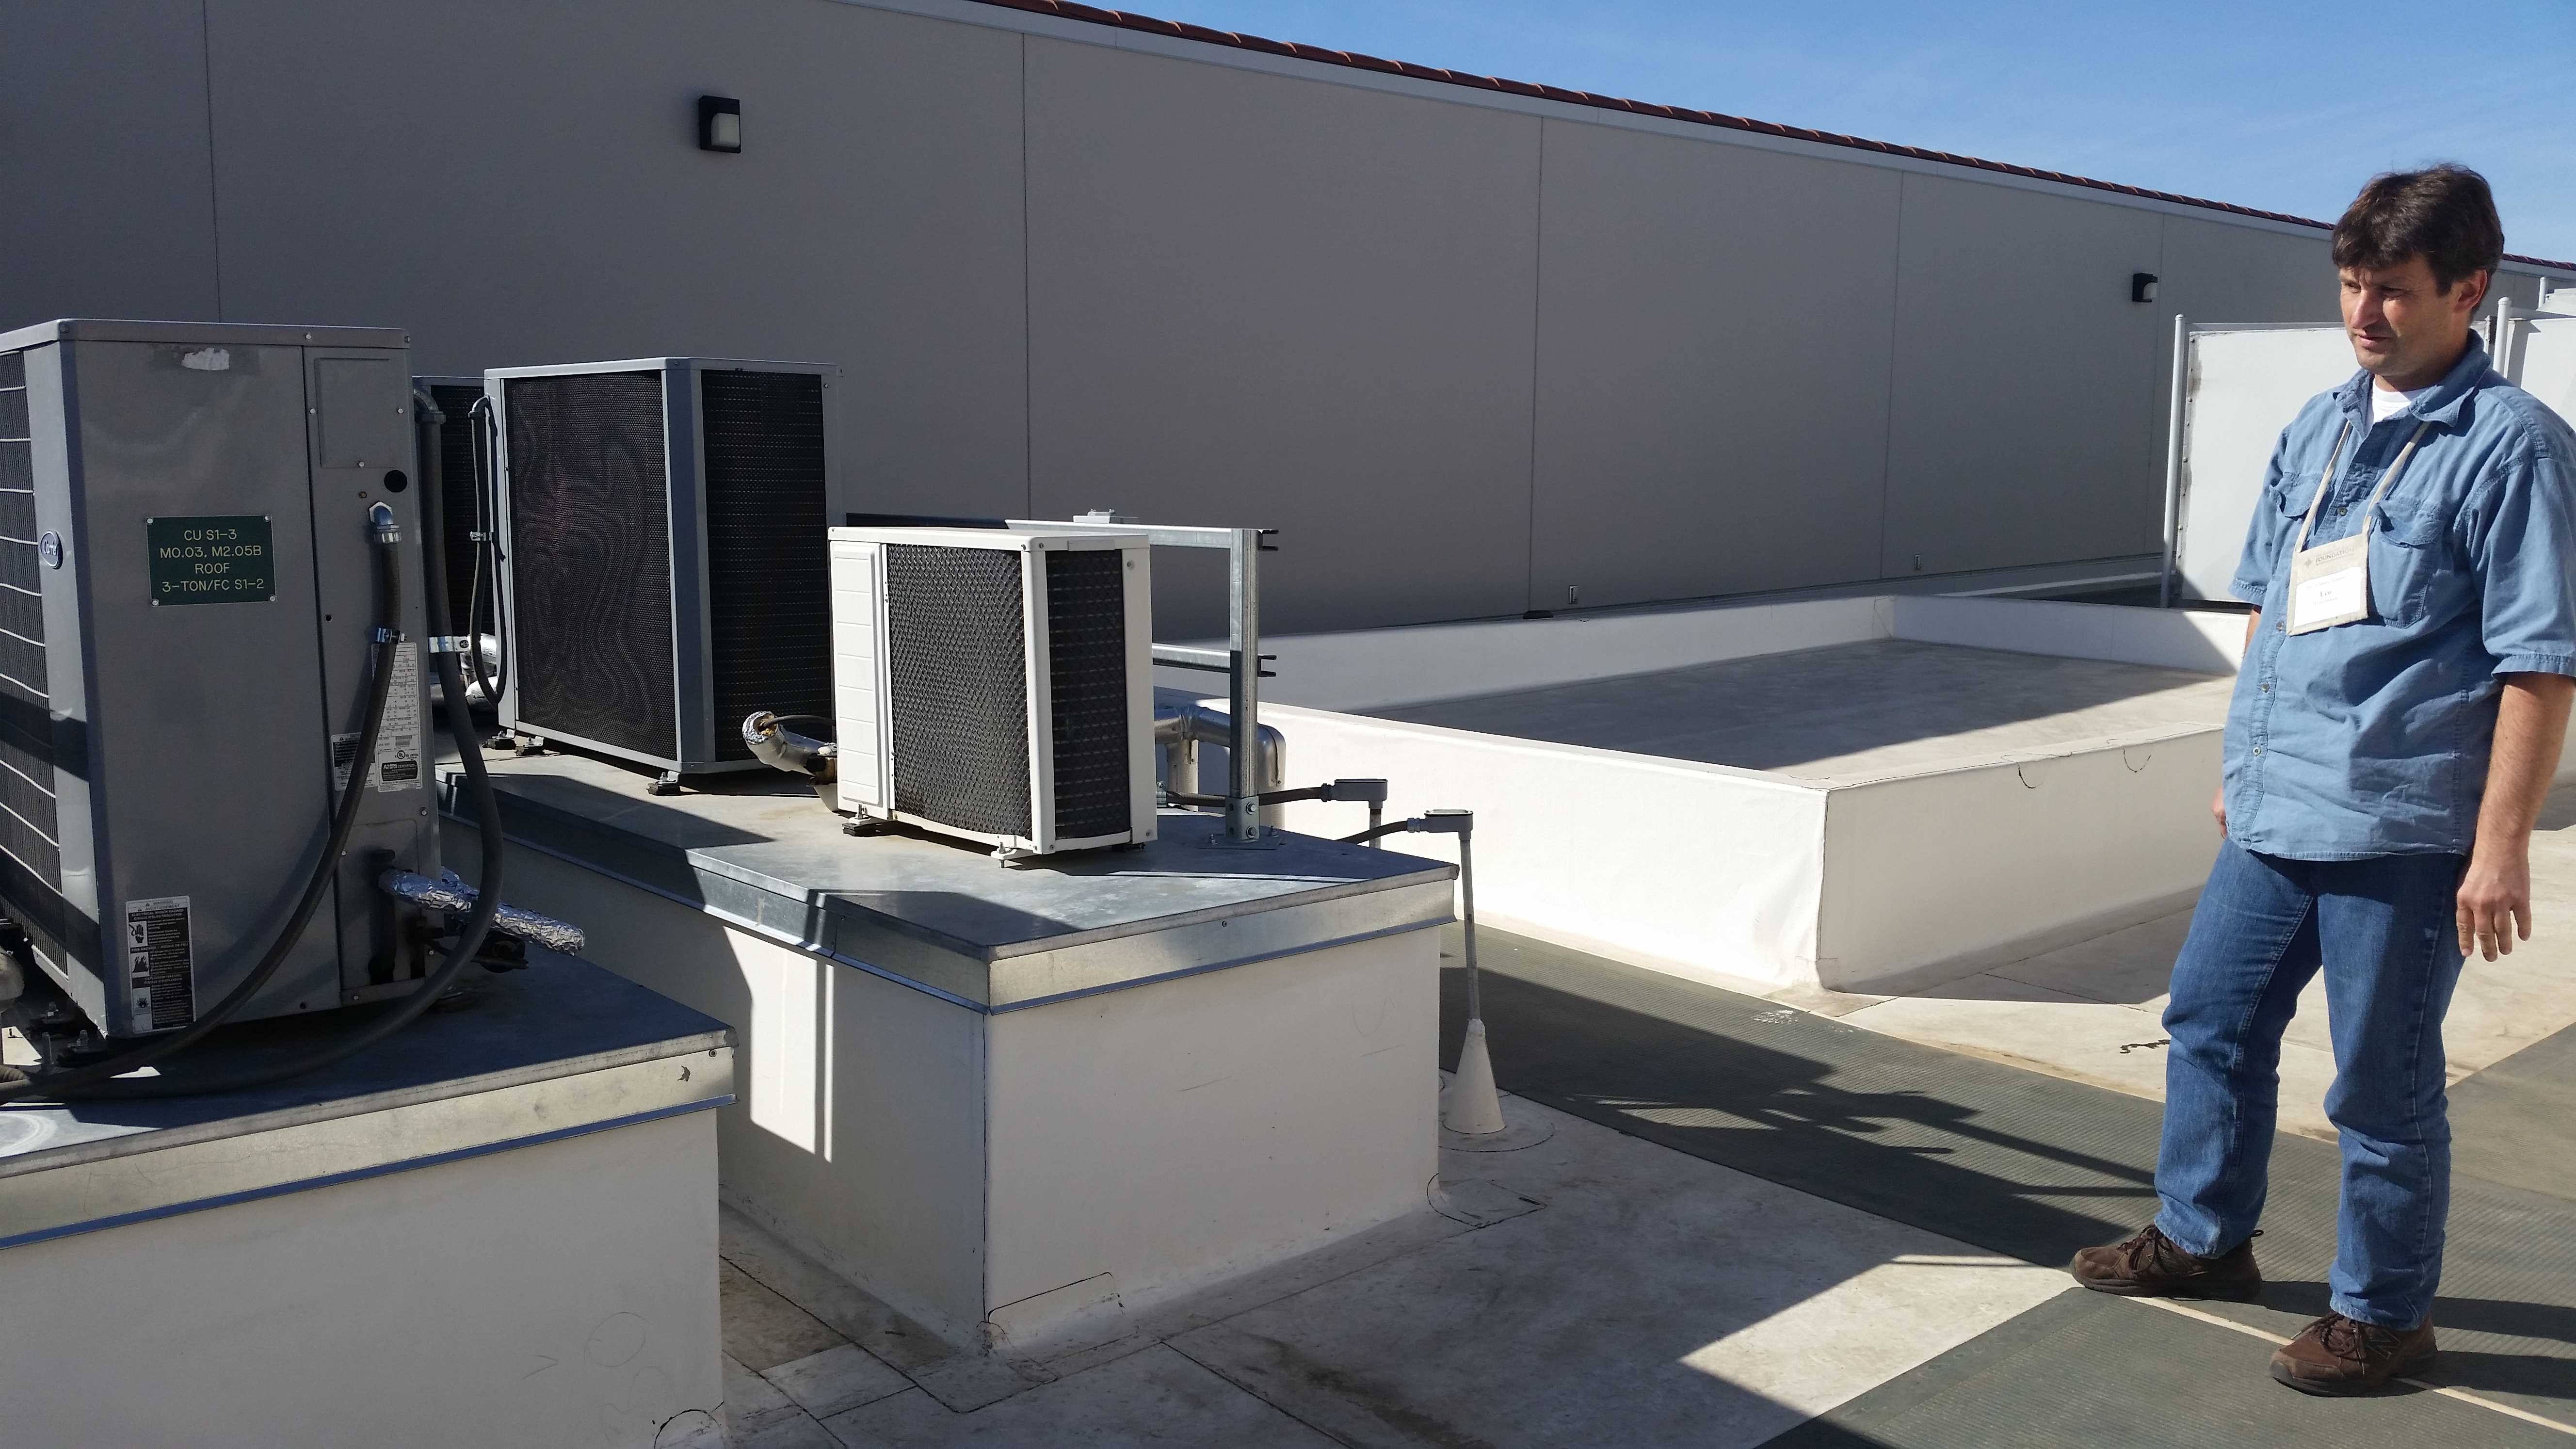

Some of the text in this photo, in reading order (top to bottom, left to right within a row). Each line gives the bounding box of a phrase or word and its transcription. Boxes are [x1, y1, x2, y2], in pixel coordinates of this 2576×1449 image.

[184, 529, 237, 541] CU S1-3
[43, 540, 57, 556] Carrie
[212, 545, 262, 557] M2.05B
[2316, 547, 2354, 563] FOUNDATION
[194, 563, 230, 574] ROOF
[161, 579, 264, 592] 3-TON/FC S1-2
